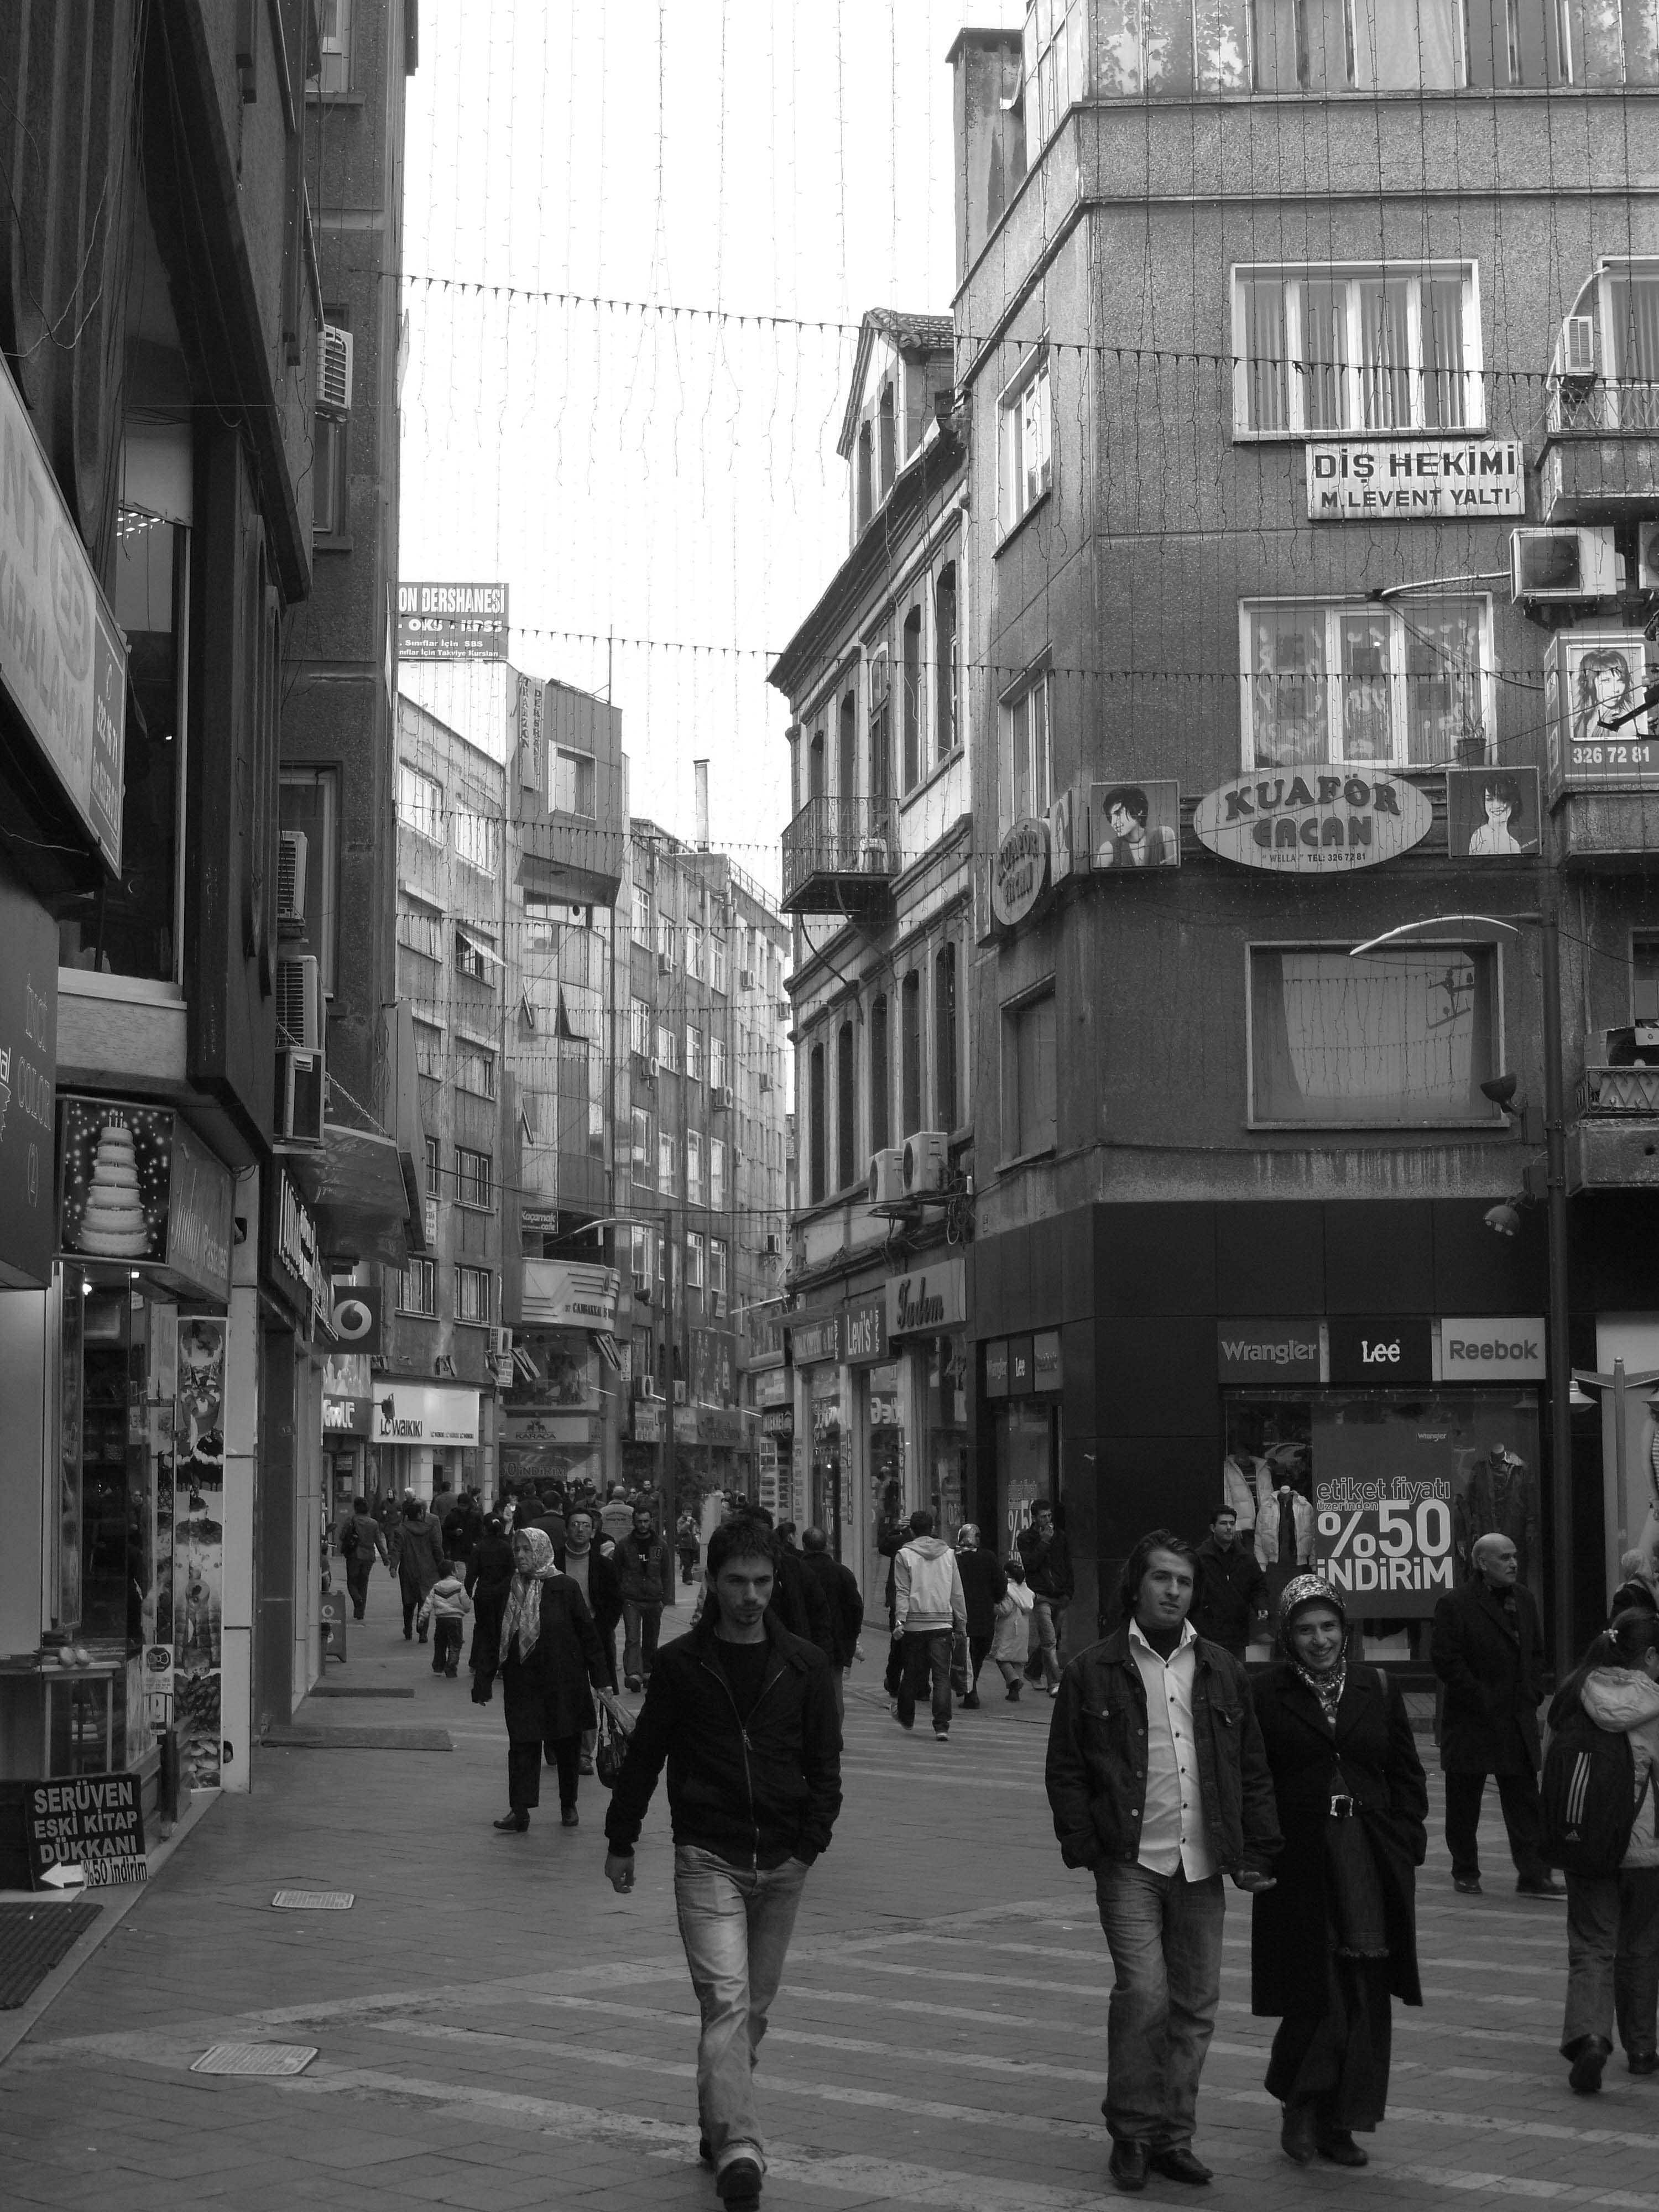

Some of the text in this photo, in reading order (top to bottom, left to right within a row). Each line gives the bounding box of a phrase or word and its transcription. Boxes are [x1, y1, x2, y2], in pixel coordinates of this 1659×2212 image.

[1315, 445, 1515, 483] DİŞ HEKİMİ
[1349, 490, 1442, 507] LEVENT
[1450, 488, 1510, 505] YALTI
[422, 584, 504, 613] DERSHANESİ
[409, 619, 442, 631] OKS
[421, 648, 435, 656] İçin
[441, 639, 458, 648] İçin
[1573, 747, 1650, 764] 326 72 81
[1225, 774, 1401, 821] KUAFÖR
[1270, 854, 1295, 862] WELLA
[1328, 853, 1343, 862] 326
[1357, 852, 1365, 860] 81
[847, 1311, 870, 1355] Levi's
[1221, 1339, 1316, 1364] Wrangler
[1362, 1340, 1401, 1363] Lee
[1449, 1339, 1538, 1360] Reebok
[1317, 1477, 1450, 1504] etiket fiyatı
[1317, 1500, 1379, 1511] üzerinden
[1317, 1499, 1451, 1558] %50
[34, 1780, 133, 1813] SERÜVEN
[34, 1808, 137, 1838] ESKİ KİTAP
[40, 1835, 137, 1863] DÜKKANI
[85, 1857, 148, 1885] %50 indirim
